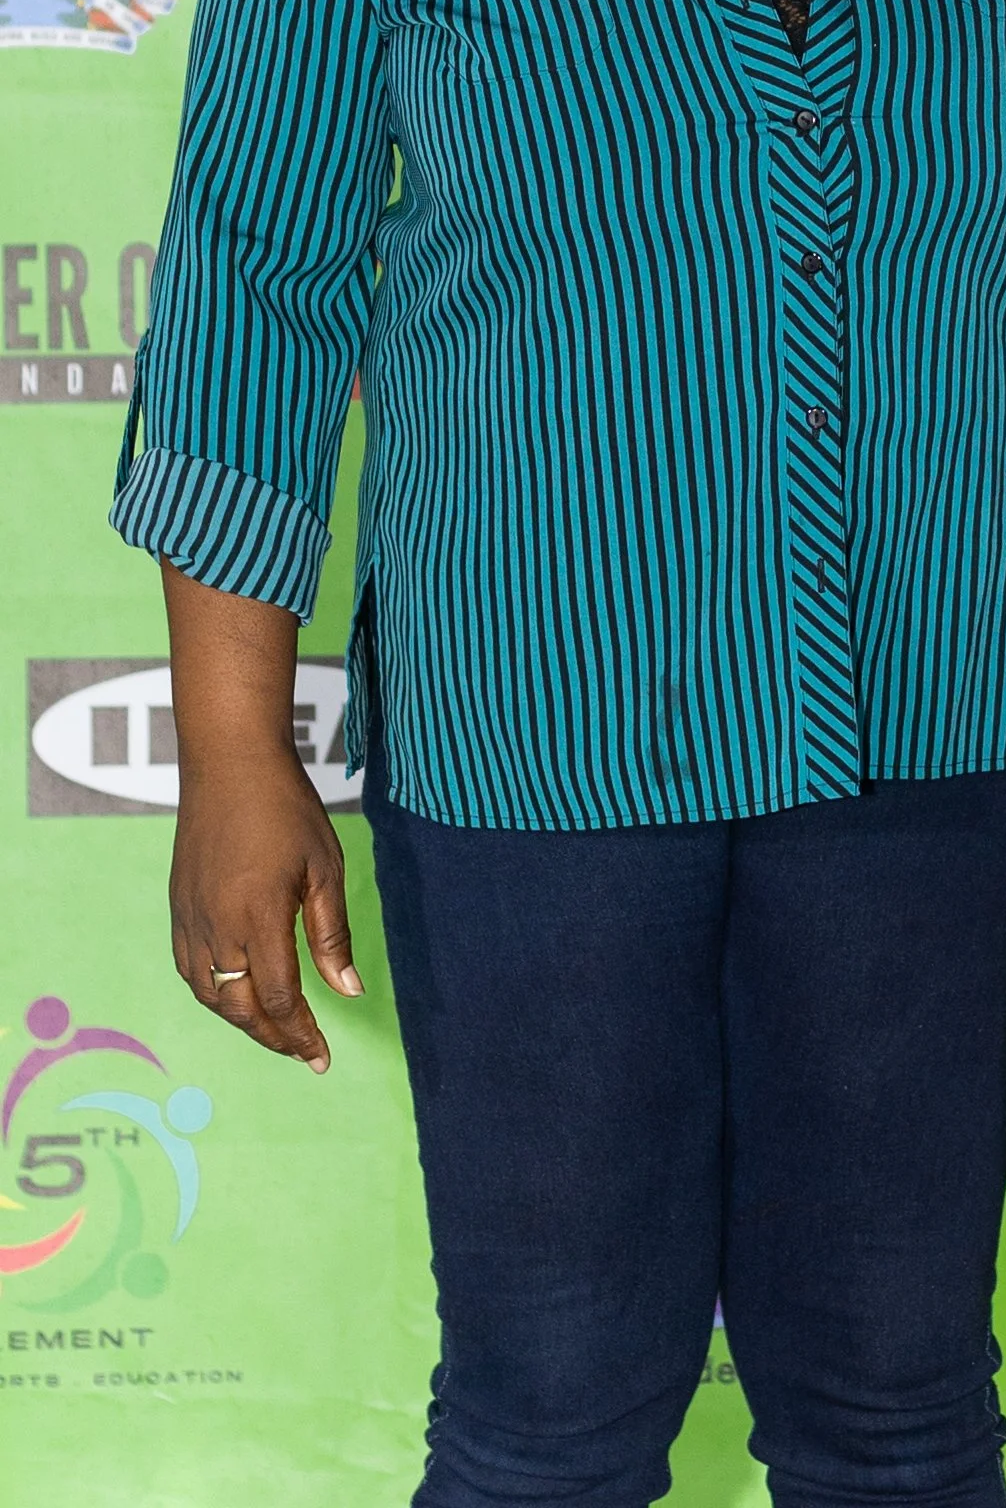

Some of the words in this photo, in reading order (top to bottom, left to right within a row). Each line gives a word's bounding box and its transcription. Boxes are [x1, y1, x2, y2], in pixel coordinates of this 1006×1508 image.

[16, 1126, 141, 1199] 5TH
[0, 1328, 154, 1351] EMENT
[94, 1369, 244, 1386] EDUCATION
